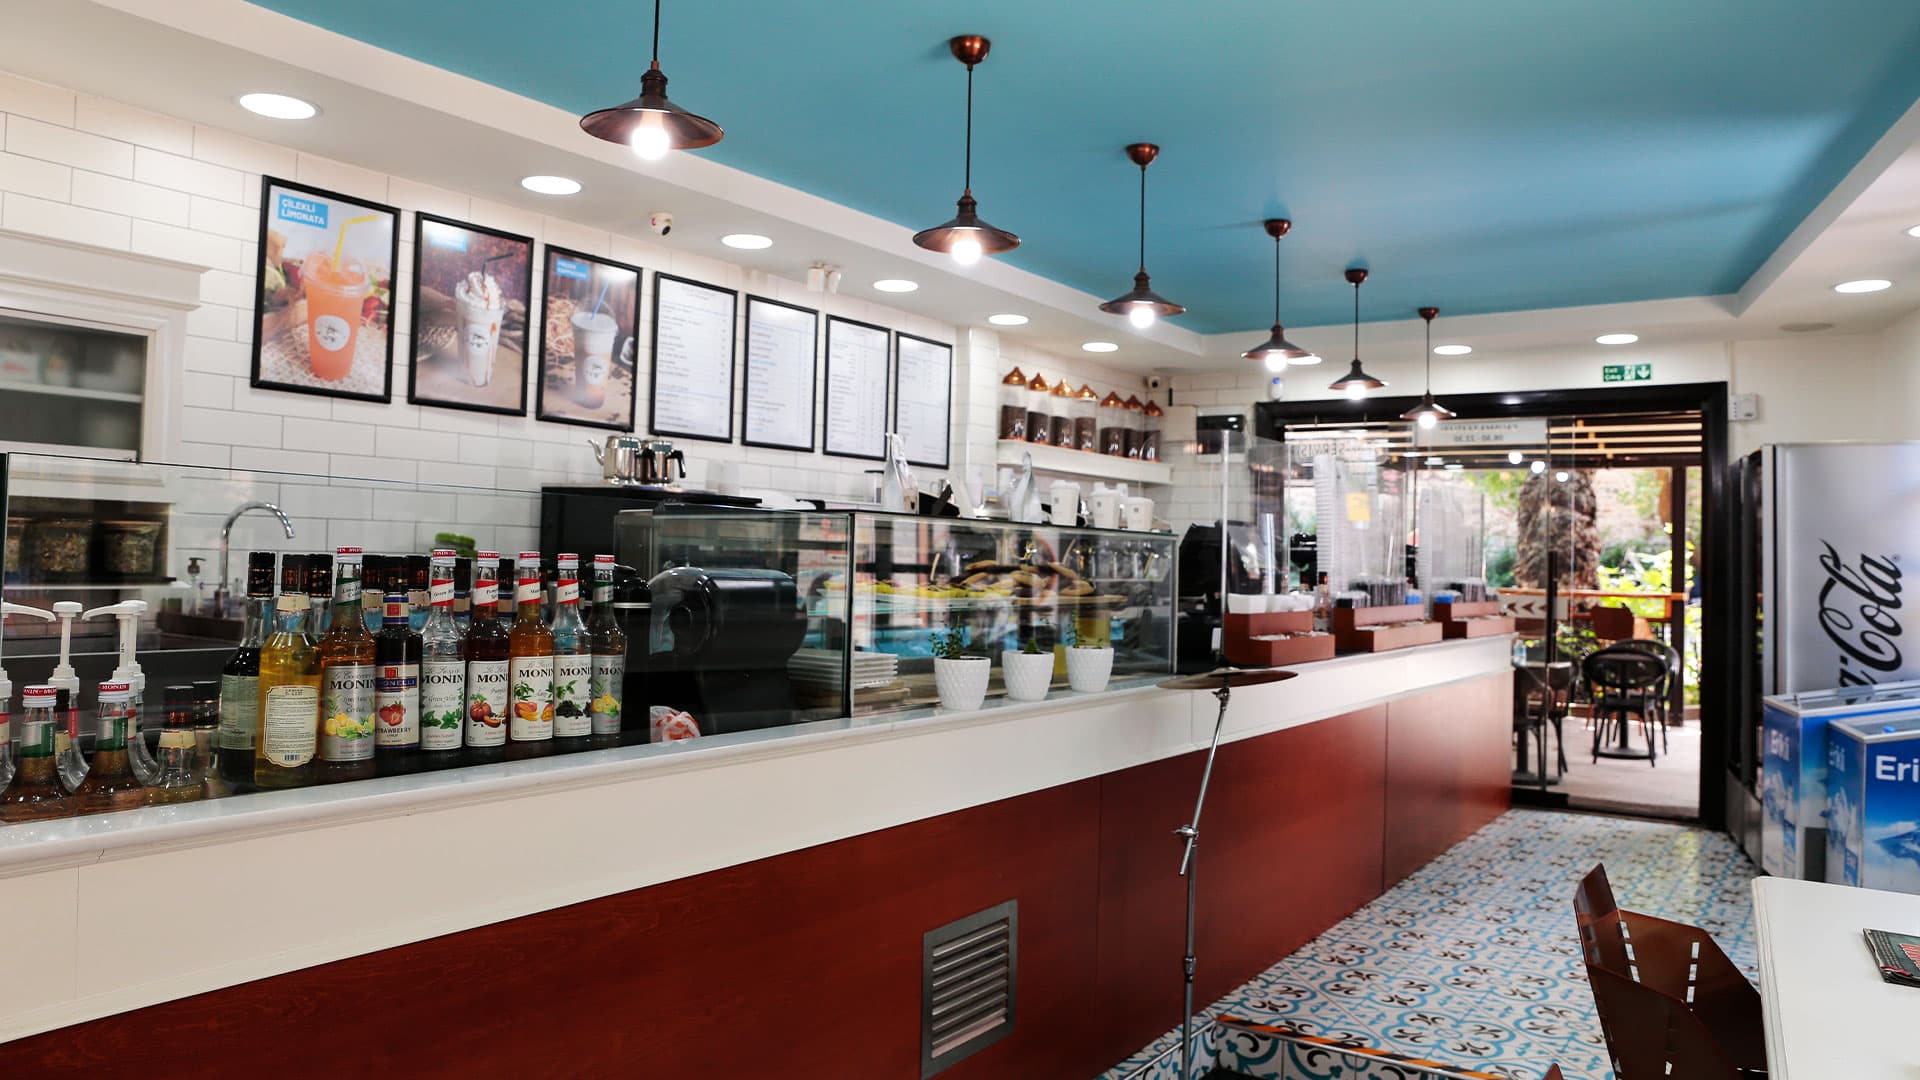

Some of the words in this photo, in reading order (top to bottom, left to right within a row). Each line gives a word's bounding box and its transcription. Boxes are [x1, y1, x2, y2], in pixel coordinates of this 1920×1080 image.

[560, 666, 591, 676] MONI
[599, 666, 624, 675] MON
[477, 673, 508, 683] MONI
[1875, 755, 1920, 783] Eri
